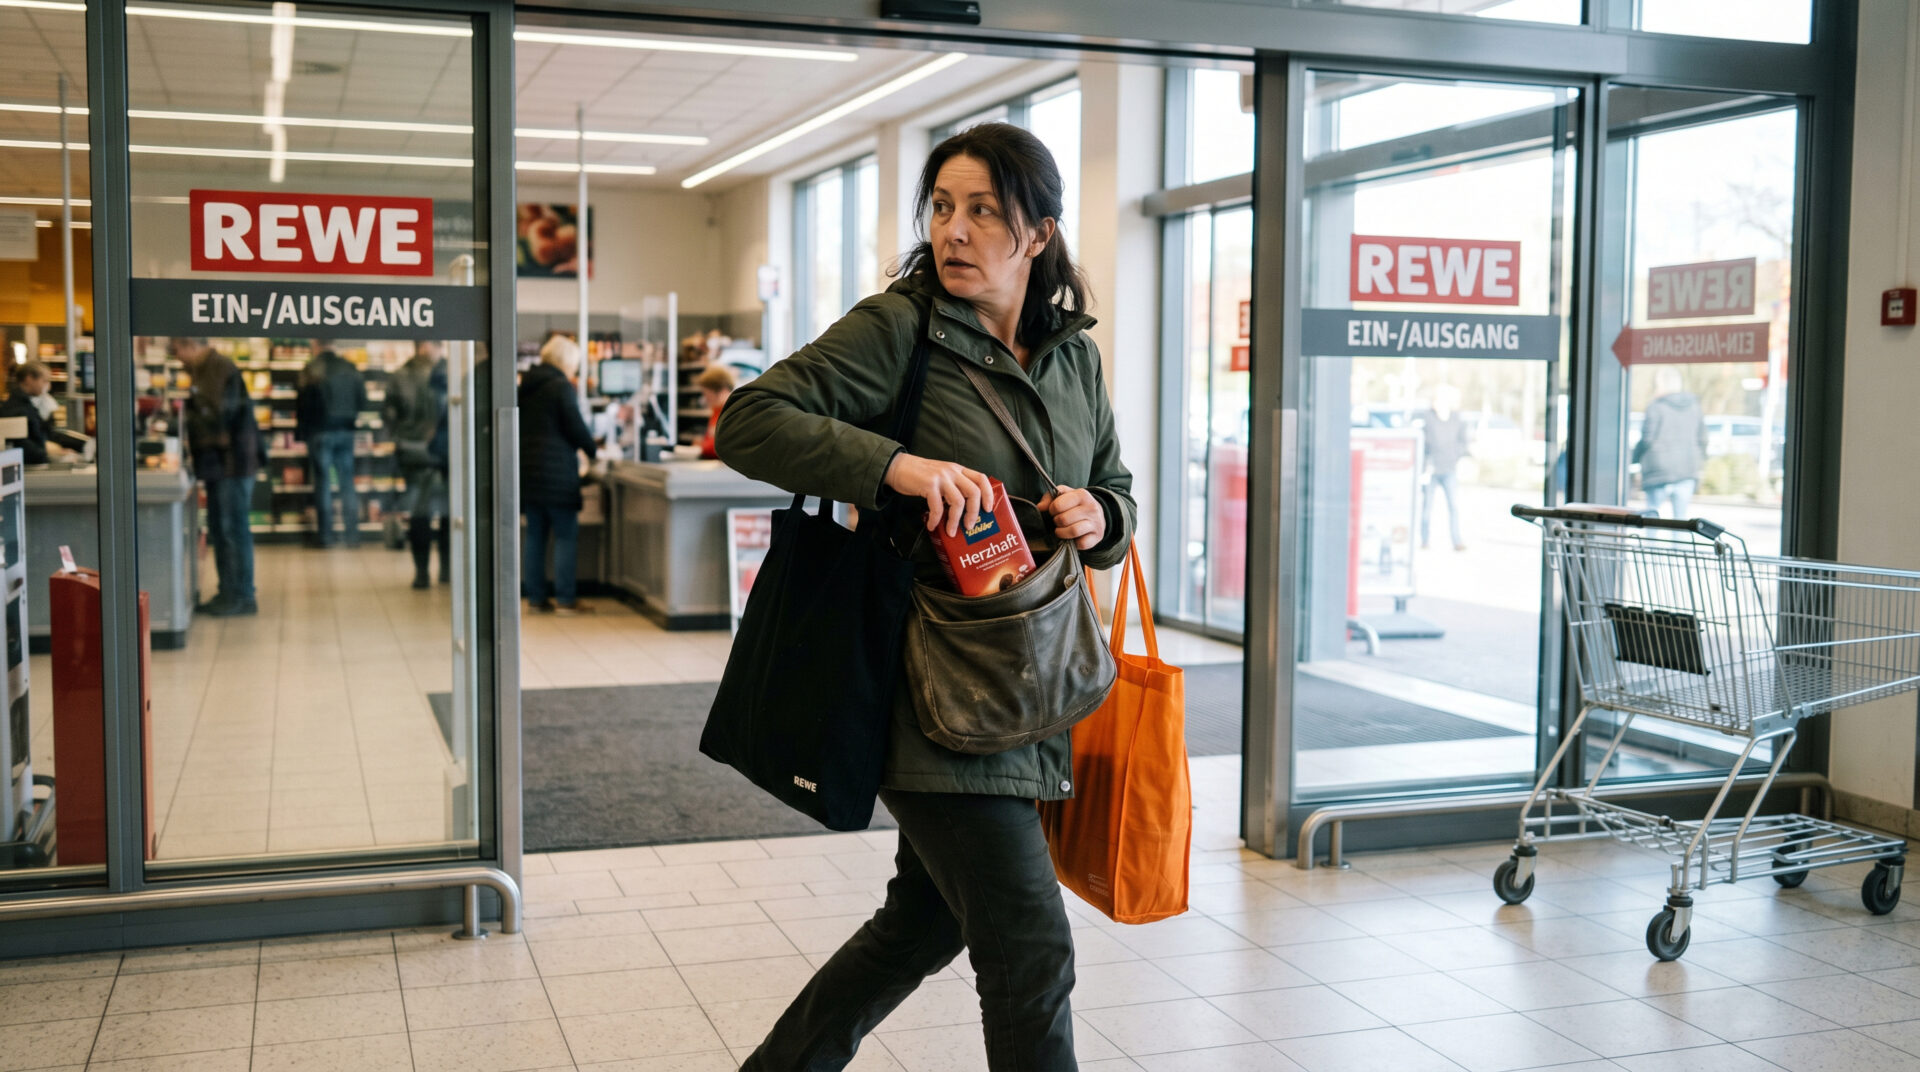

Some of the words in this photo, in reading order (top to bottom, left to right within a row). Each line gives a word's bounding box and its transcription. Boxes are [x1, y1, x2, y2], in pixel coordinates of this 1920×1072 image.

[203, 201, 422, 266] REWE
[1358, 243, 1514, 298] REWE
[191, 292, 435, 330] EIN-/AUSGANG
[1347, 319, 1520, 352] EIN-/AUSGANG
[959, 533, 1019, 569] Herzhaft
[793, 775, 817, 793] REWE
